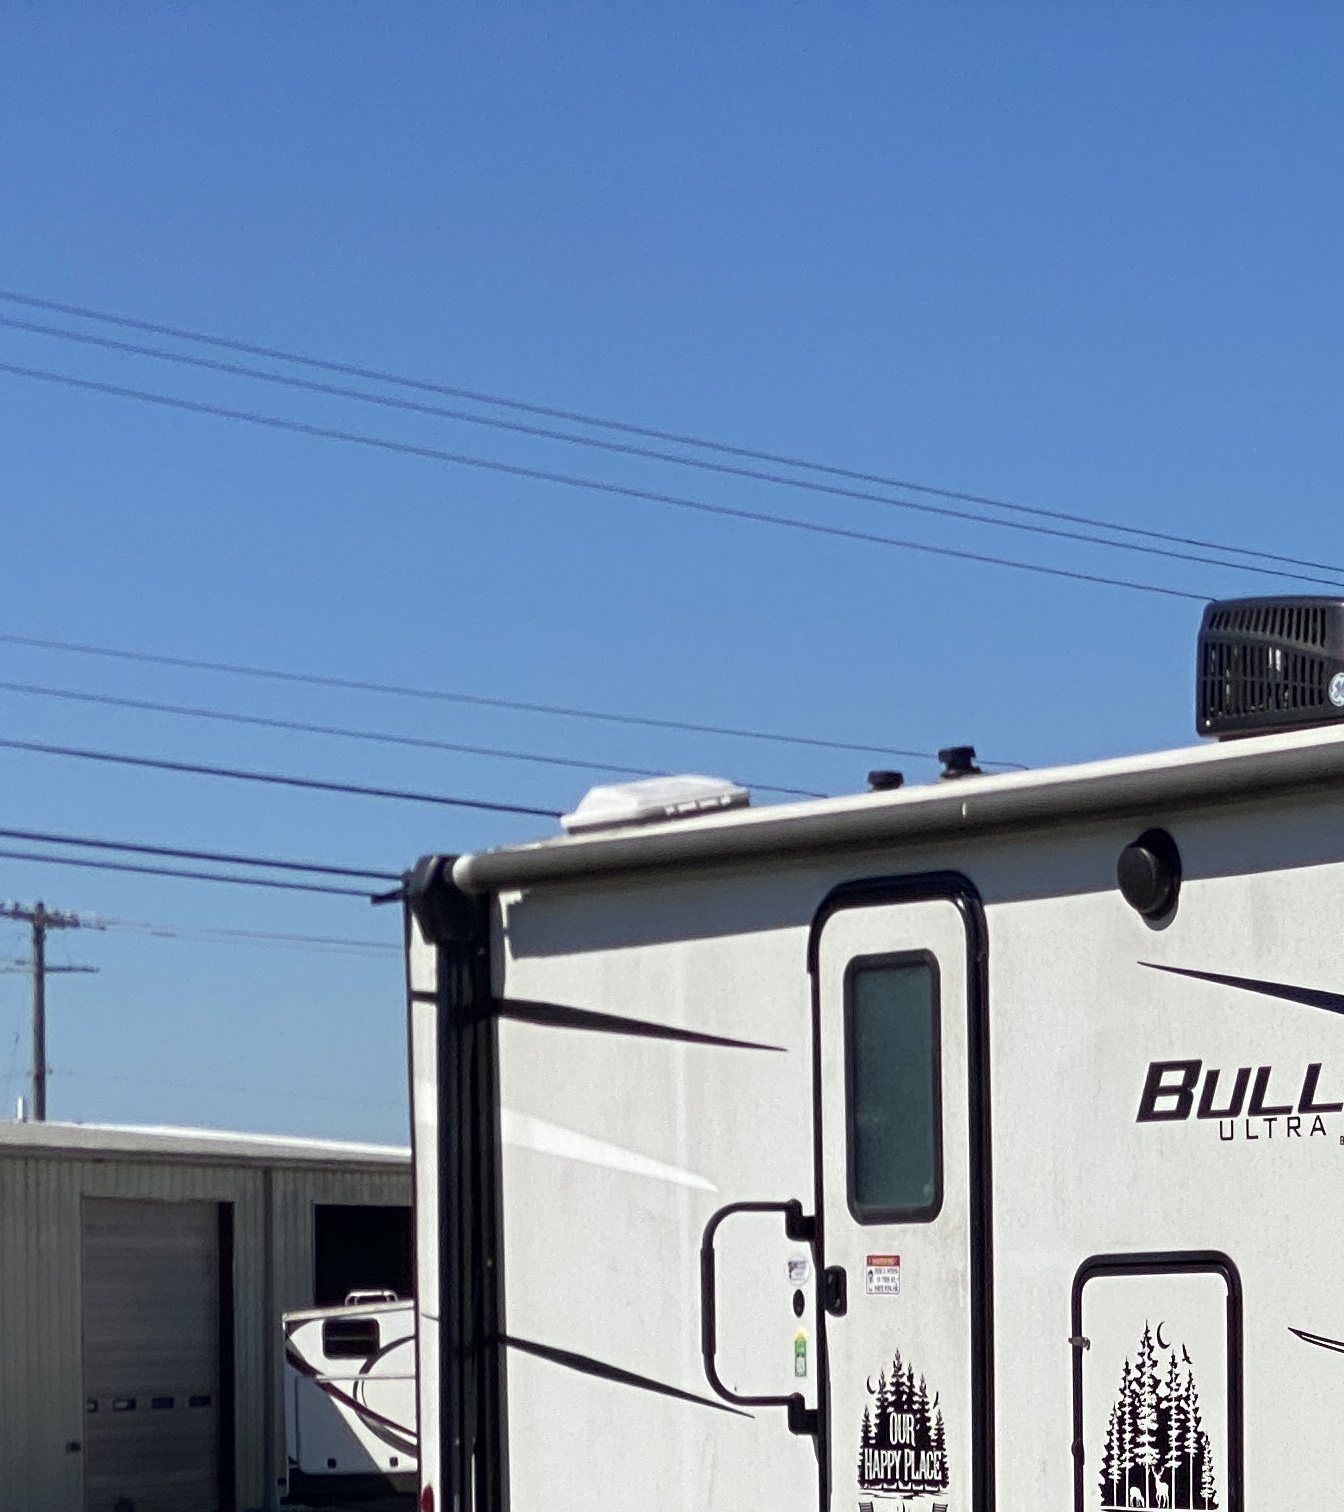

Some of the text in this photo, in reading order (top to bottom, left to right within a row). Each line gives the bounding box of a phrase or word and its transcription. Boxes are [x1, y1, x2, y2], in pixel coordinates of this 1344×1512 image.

[1218, 1114, 1327, 1141] ULTRA
[889, 1412, 916, 1447] OUR
[864, 1447, 942, 1481] HAPPY PLACE
